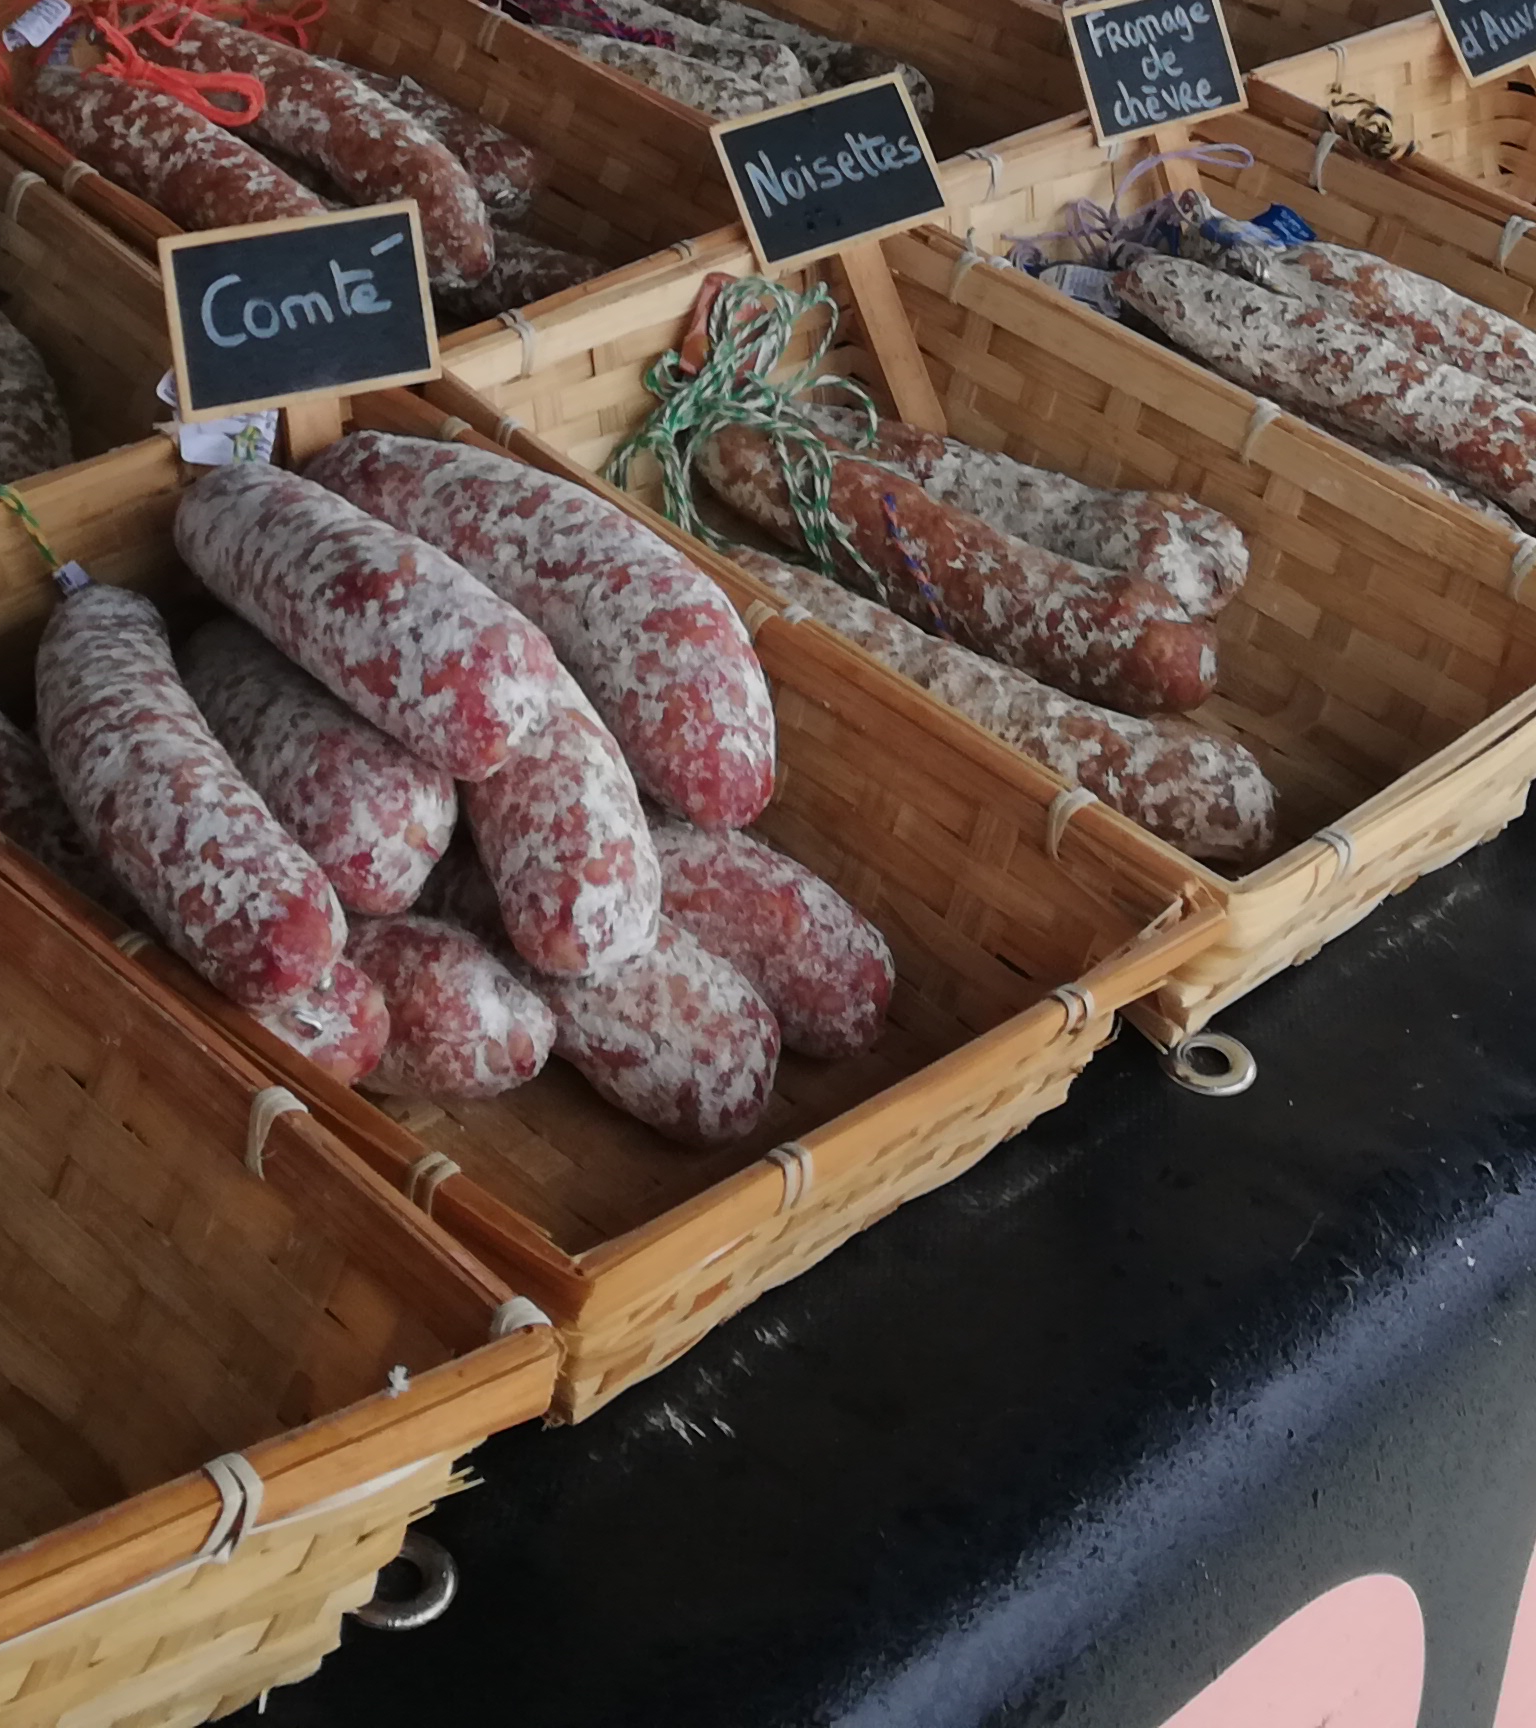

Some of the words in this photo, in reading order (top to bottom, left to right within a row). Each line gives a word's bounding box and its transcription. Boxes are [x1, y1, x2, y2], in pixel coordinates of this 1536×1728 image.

[1141, 43, 1183, 81] de
[744, 132, 922, 218] Noisettes
[201, 232, 404, 347] Comté
